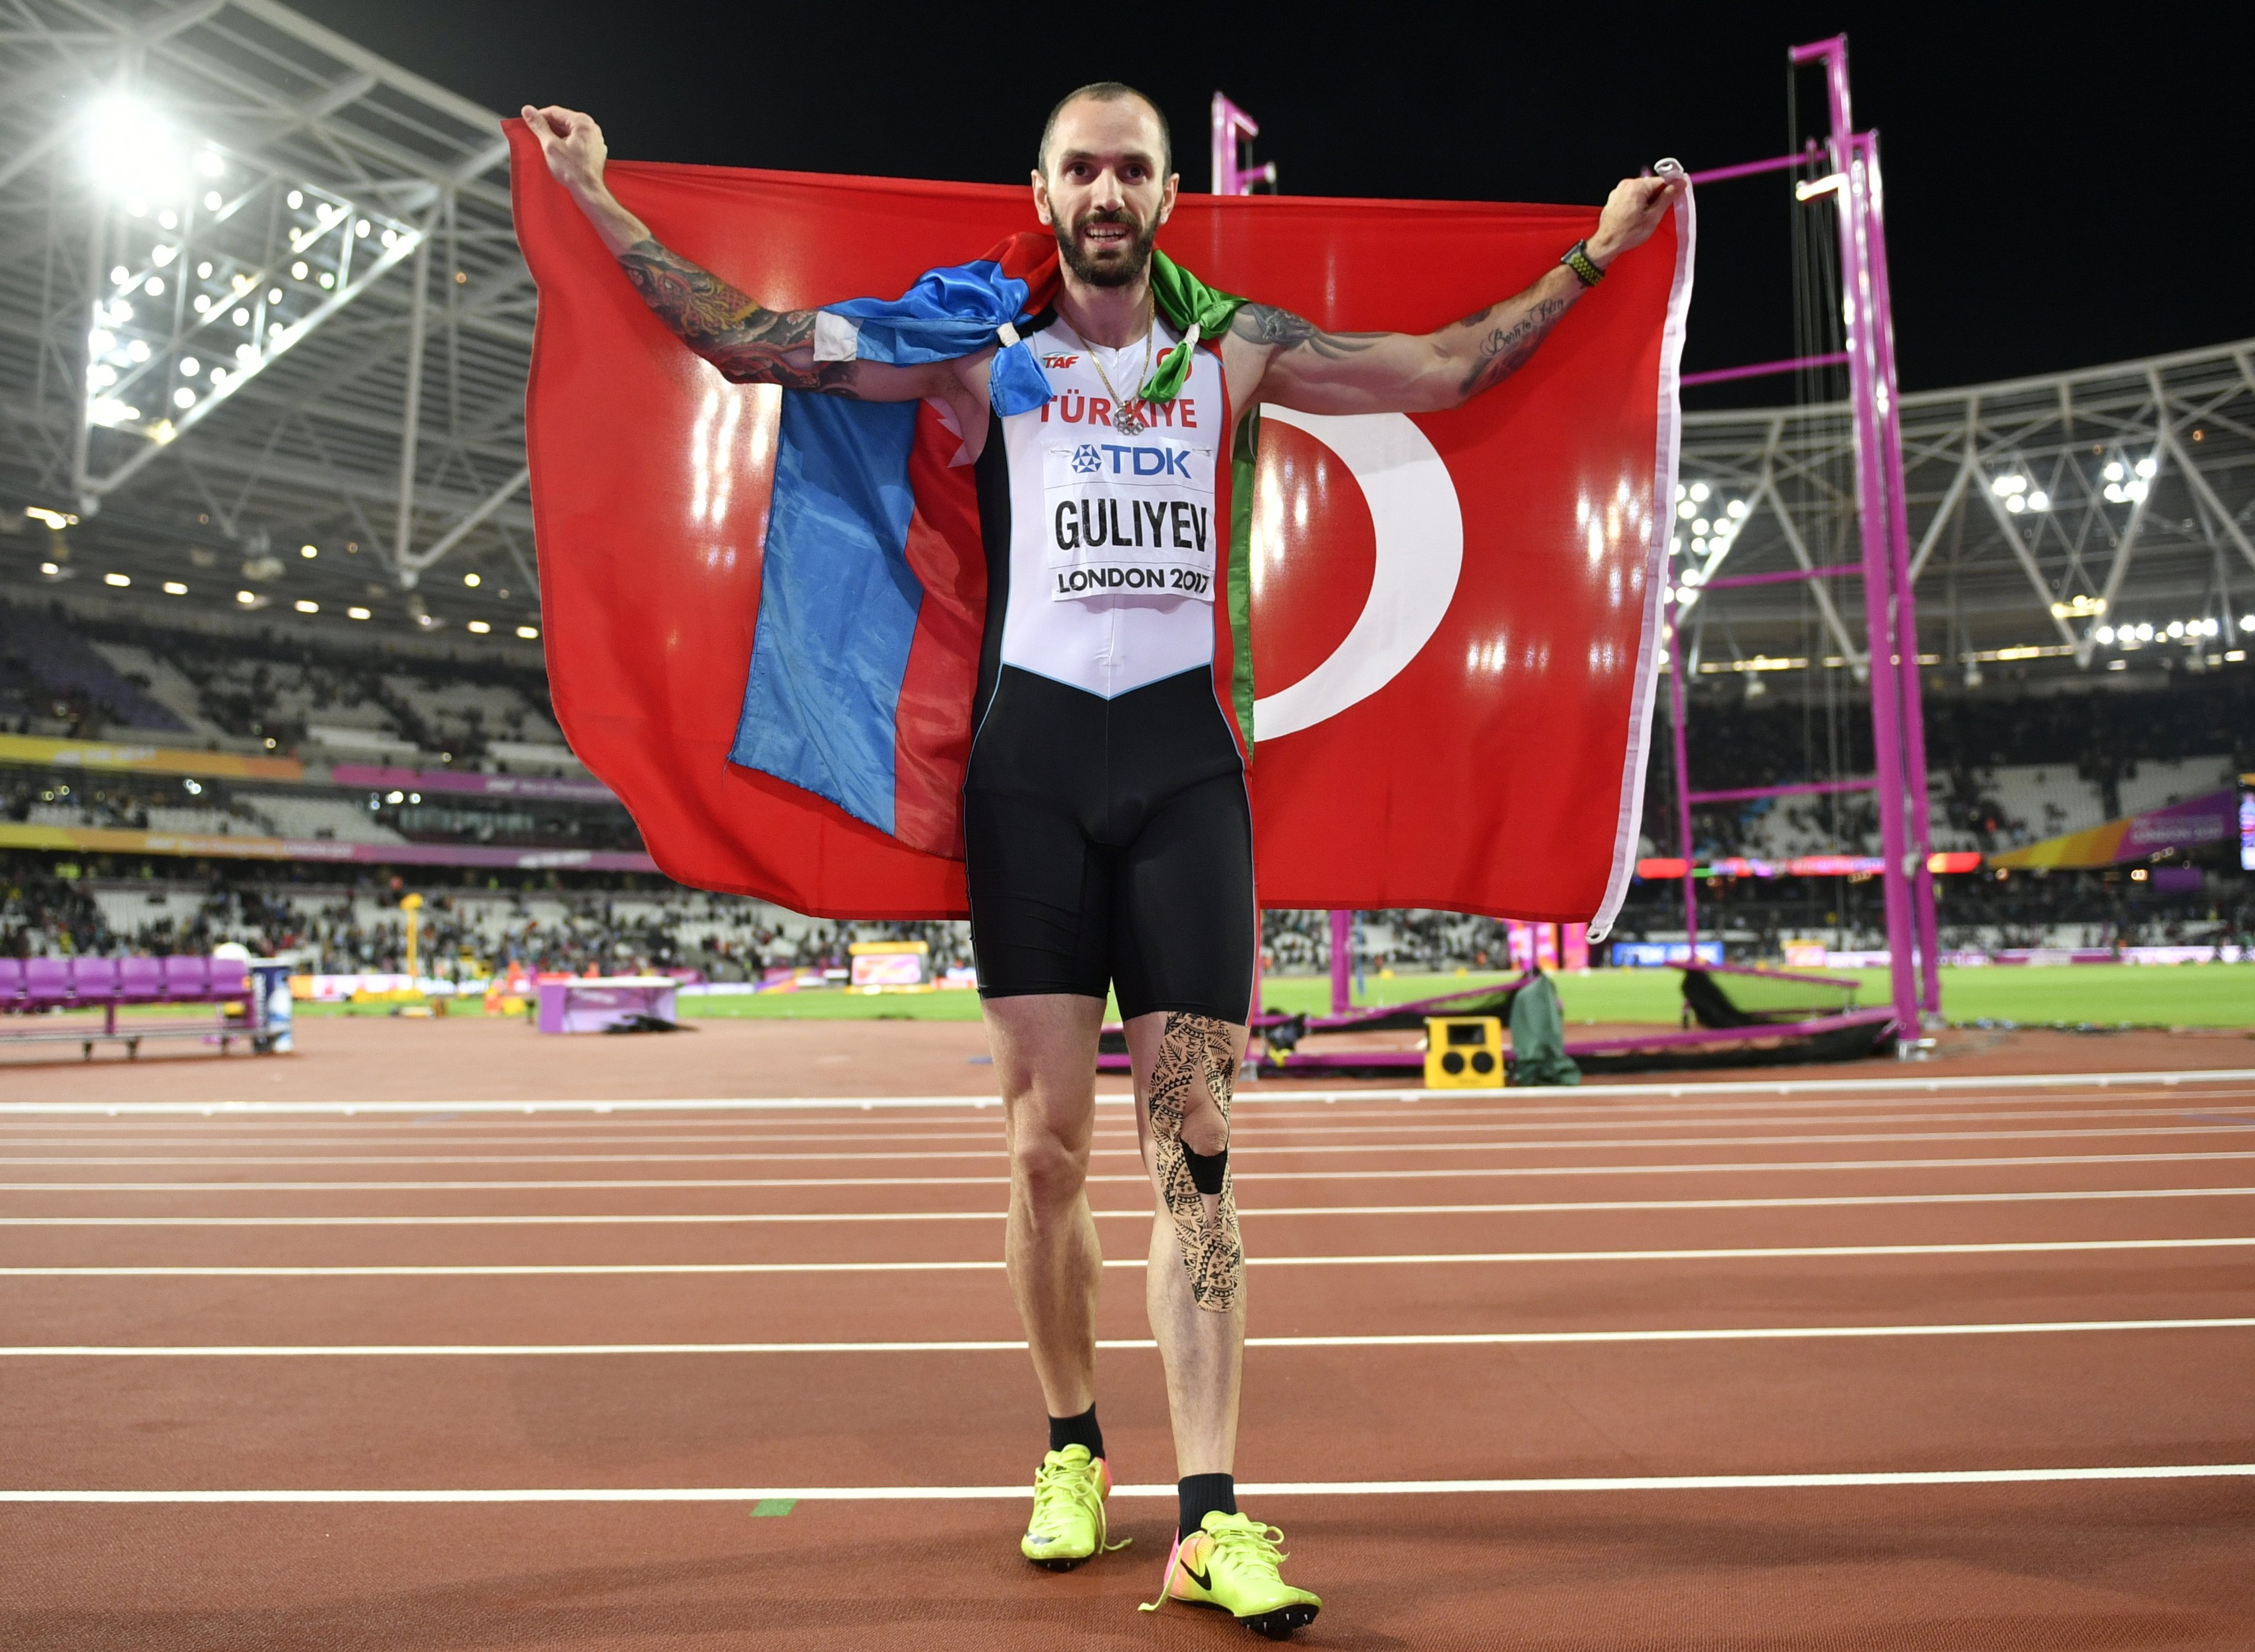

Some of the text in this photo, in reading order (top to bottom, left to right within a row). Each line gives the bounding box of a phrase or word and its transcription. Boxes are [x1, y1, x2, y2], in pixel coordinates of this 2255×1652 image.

[1042, 356, 1079, 368] TAF
[1101, 444, 1192, 479] TDK
[1055, 498, 1207, 552] GULIYEV
[1058, 568, 1210, 594] LONDON 2017
